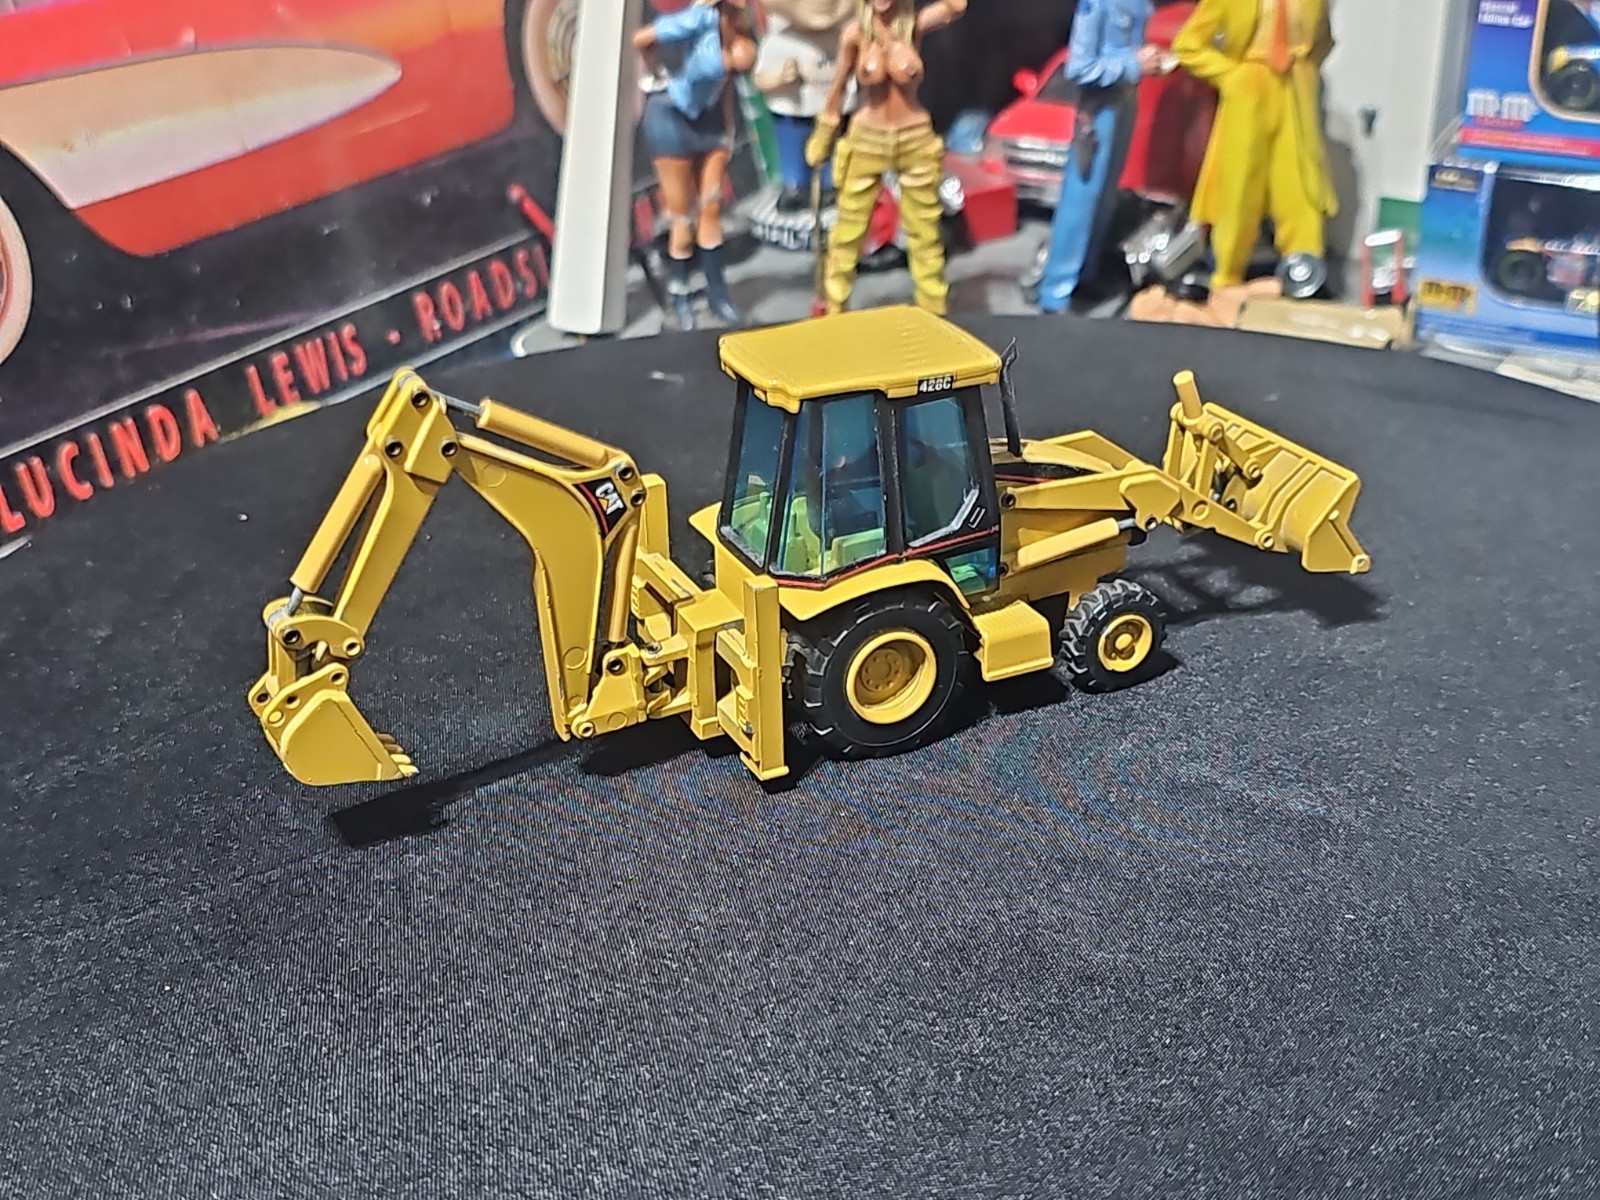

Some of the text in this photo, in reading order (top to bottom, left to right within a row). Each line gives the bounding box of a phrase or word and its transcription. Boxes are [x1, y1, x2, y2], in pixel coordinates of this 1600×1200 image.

[0, 389, 219, 534] LUCINDA
[246, 322, 368, 417] LEWIS
[595, 482, 625, 515] CAT
